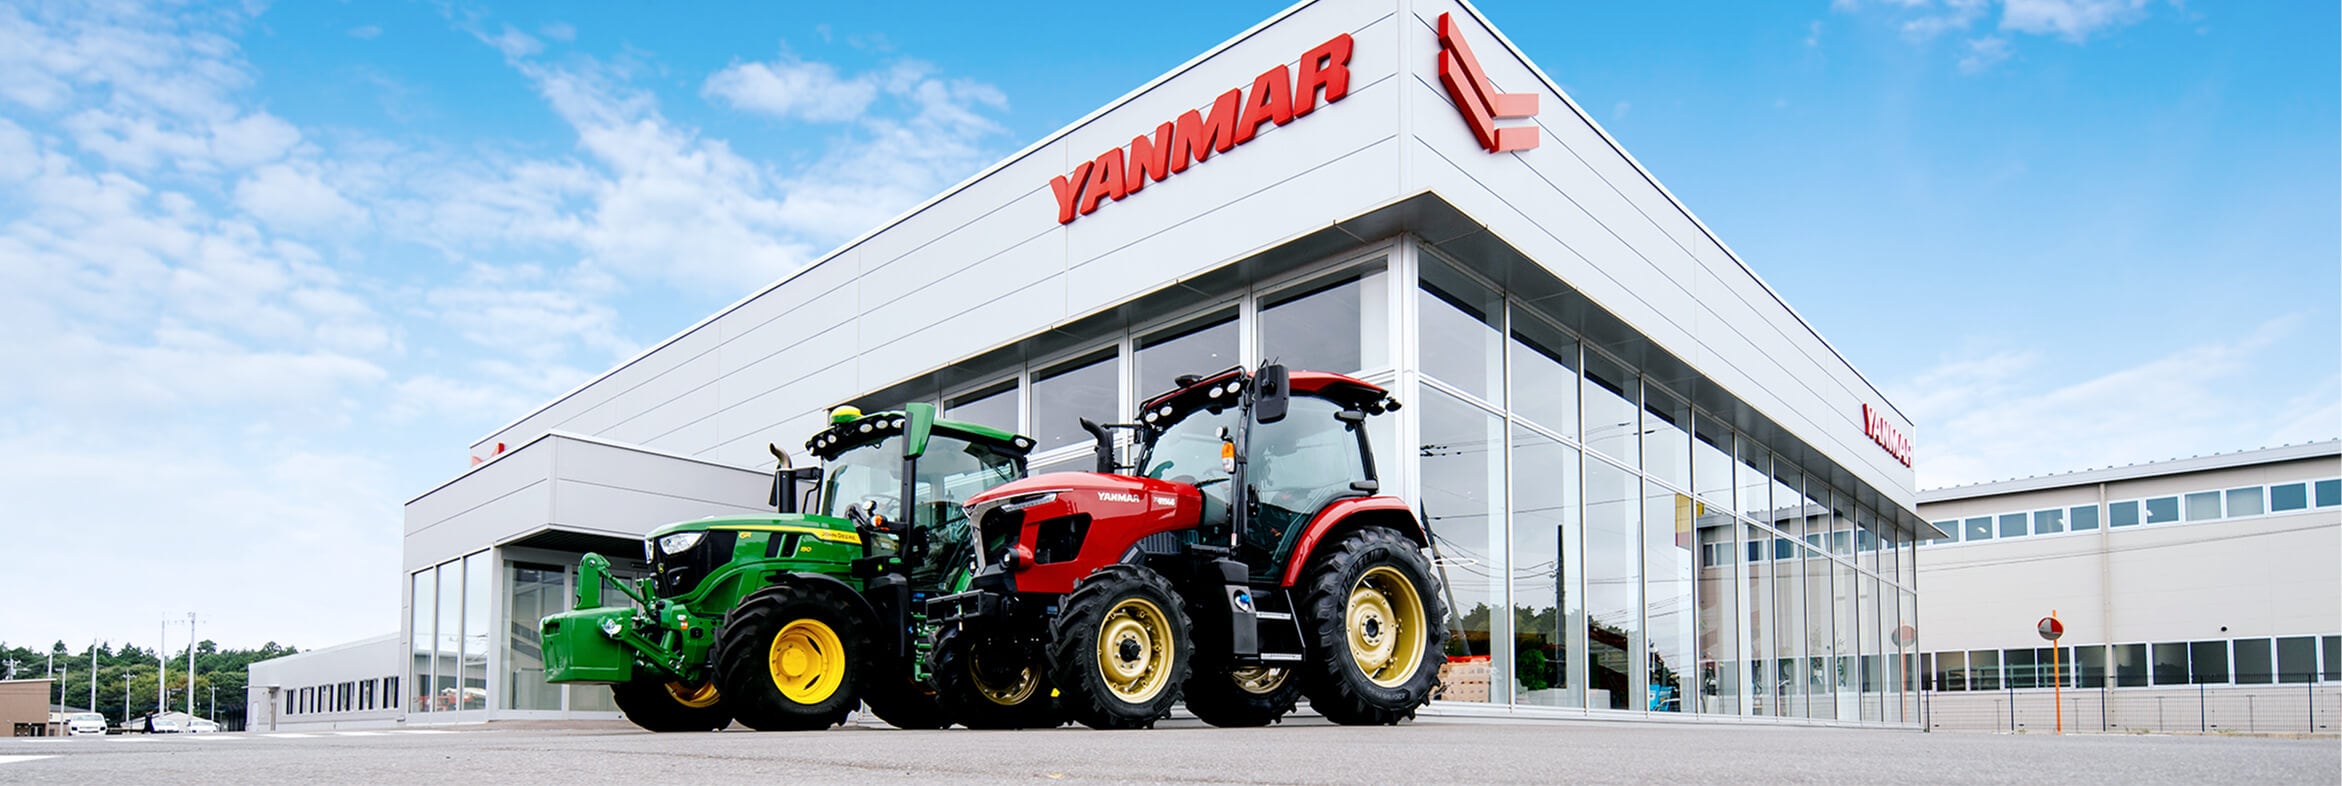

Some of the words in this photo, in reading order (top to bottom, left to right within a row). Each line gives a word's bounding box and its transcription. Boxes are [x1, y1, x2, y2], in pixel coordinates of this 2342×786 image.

[1050, 33, 1354, 225] YANMAR
[1862, 403, 1912, 468] YANMAR
[1097, 492, 1140, 503] YANMAR
